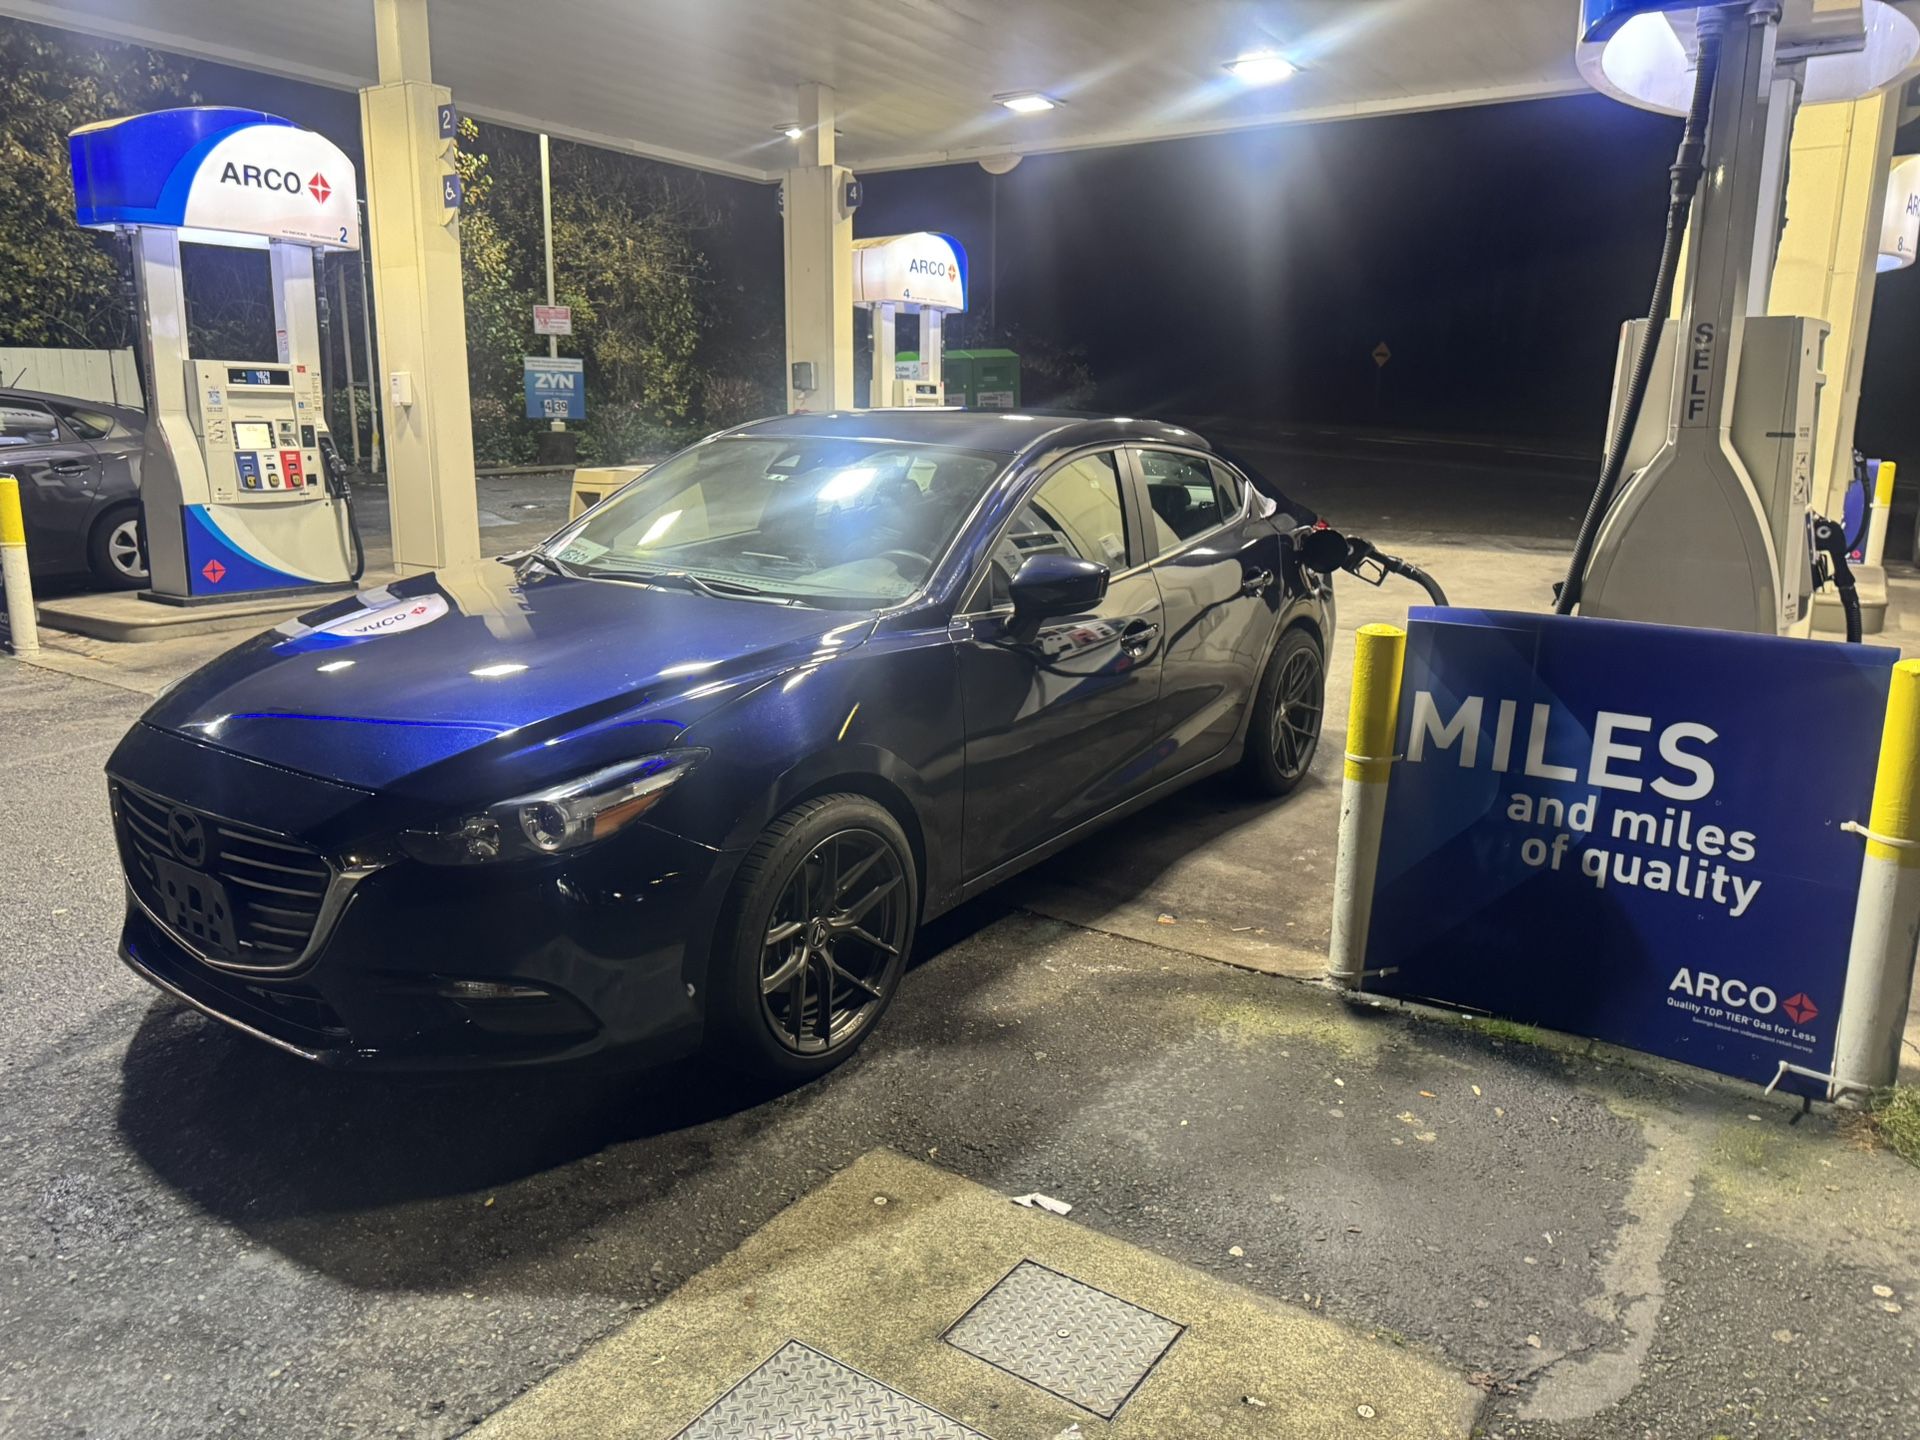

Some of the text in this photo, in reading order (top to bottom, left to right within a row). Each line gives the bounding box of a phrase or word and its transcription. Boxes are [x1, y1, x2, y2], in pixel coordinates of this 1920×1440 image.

[442, 110, 451, 130] 2
[220, 162, 301, 194] ARCO
[850, 186, 857, 200] 4
[340, 226, 348, 243] 2
[1897, 235, 1904, 252] 8
[909, 258, 945, 277] ARCO
[903, 288, 911, 299] 4
[534, 373, 575, 390] ZYN
[1688, 322, 1714, 420] SELF
[1406, 690, 1719, 801] MILES
[1506, 793, 1757, 862] and miles
[1520, 833, 1762, 917] of quality
[1668, 967, 1777, 1014] ARCO
[1666, 996, 1701, 1014] Quality
[1703, 1005, 1723, 1017] TOP
[1753, 1018, 1772, 1031] Gas
[1774, 1024, 1790, 1036] for
[1792, 1028, 1817, 1043] Less
